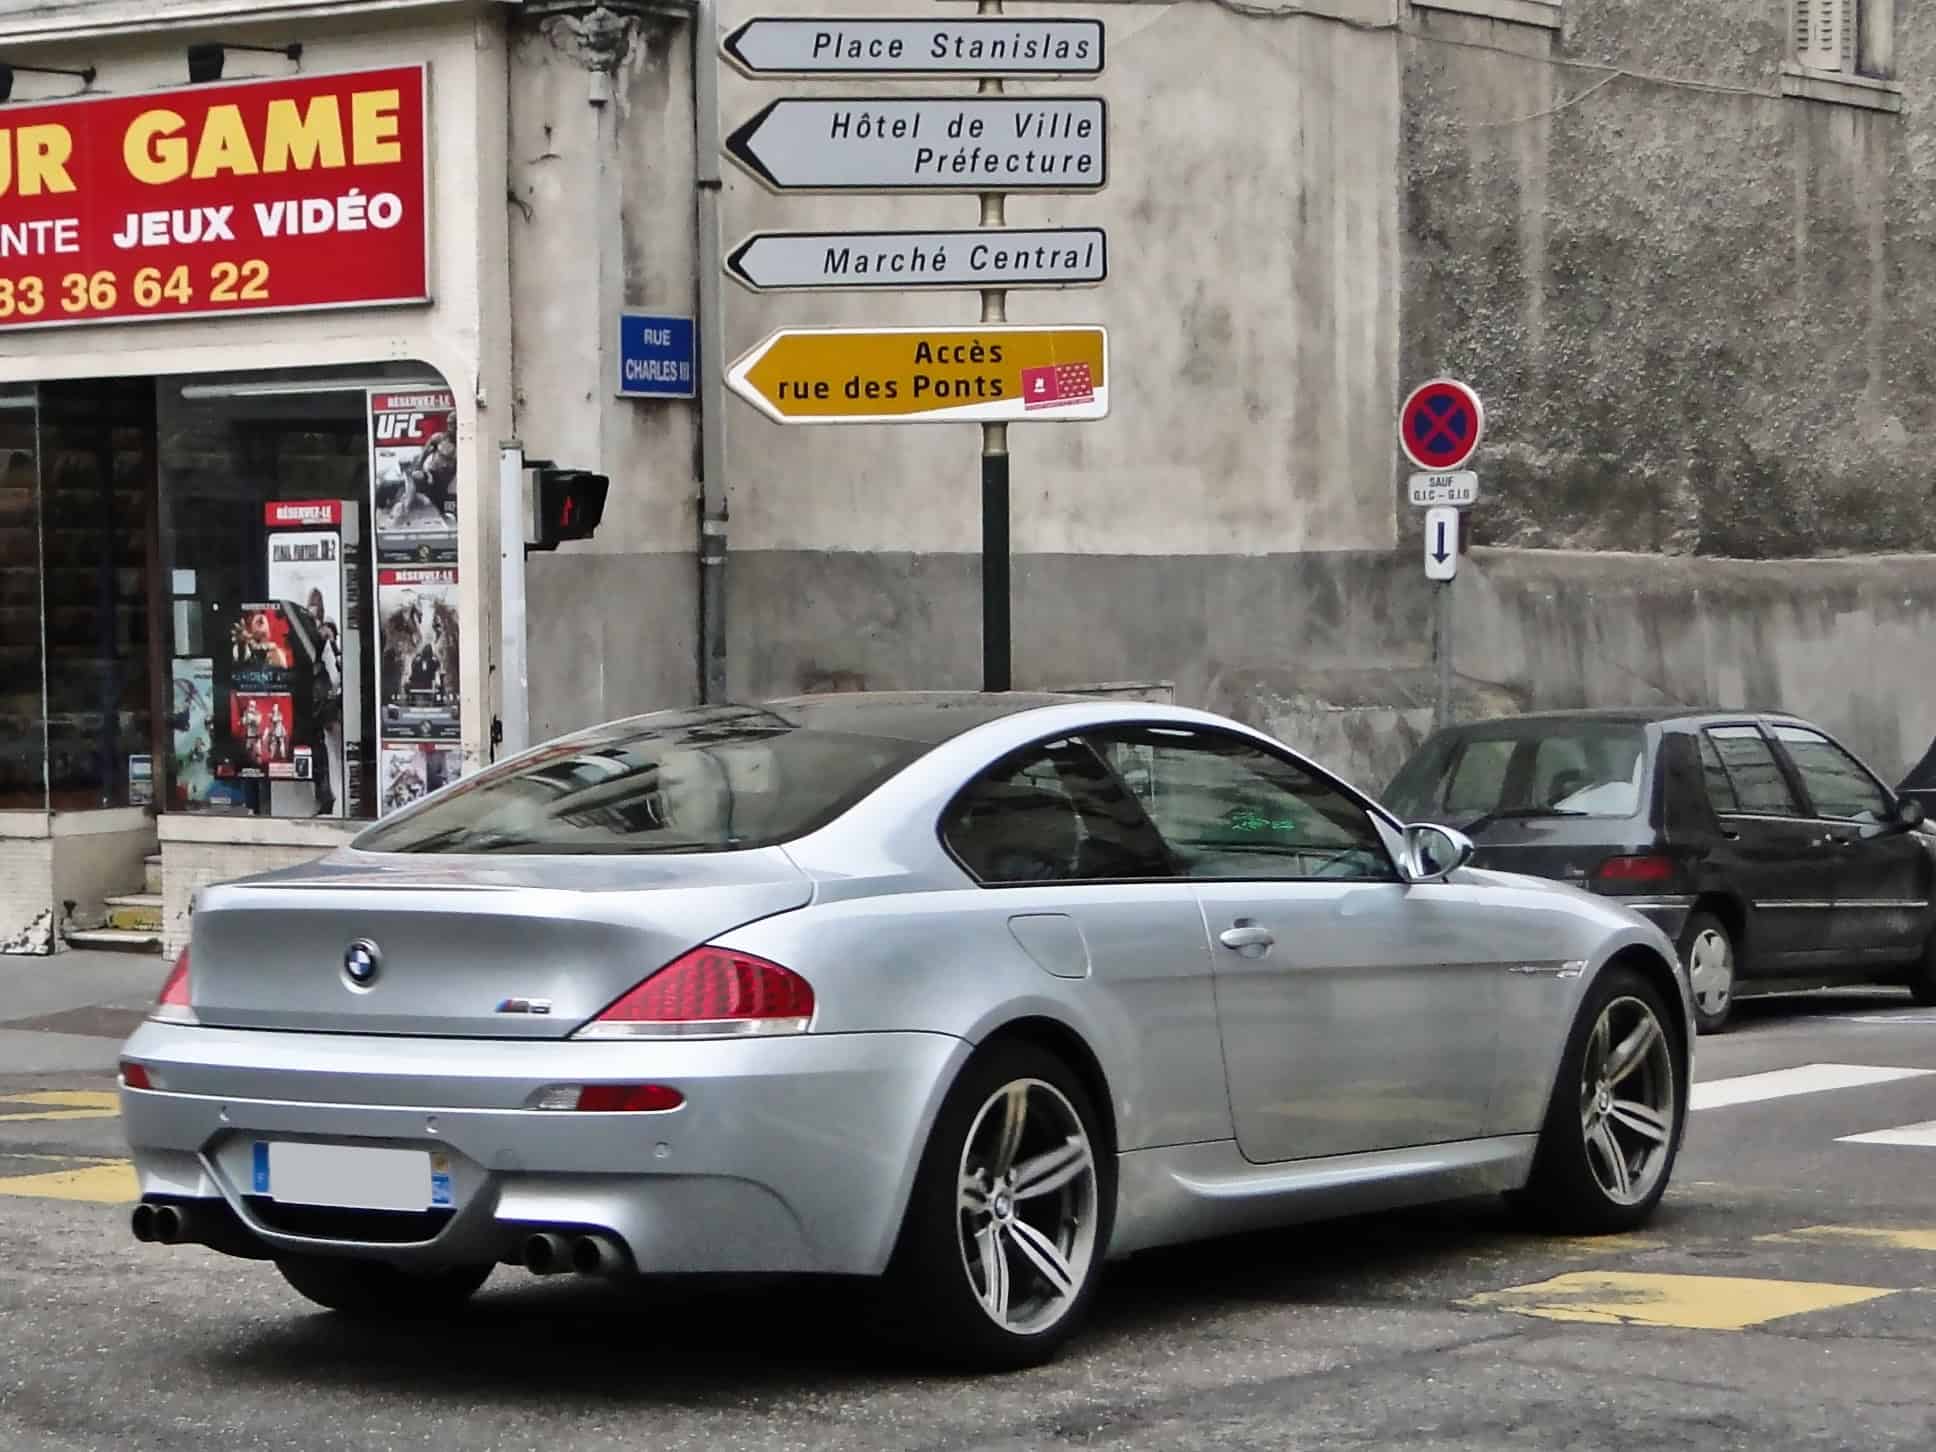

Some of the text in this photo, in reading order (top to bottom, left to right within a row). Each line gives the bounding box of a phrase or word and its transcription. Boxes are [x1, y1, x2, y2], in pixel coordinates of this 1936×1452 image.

[812, 32, 1089, 59] Place Stanislas
[123, 89, 402, 185] GAME
[831, 112, 1092, 139] Hôtel de Ville
[915, 147, 1092, 174] Préfecture
[113, 205, 235, 249] JEUX
[253, 188, 403, 239] VIDÉO
[824, 242, 1093, 274] Marché Central
[61, 271, 117, 312] 36
[132, 265, 193, 308] 64
[210, 259, 270, 302] 22
[643, 327, 672, 346] RUE
[915, 340, 1003, 364] Accès
[625, 358, 677, 381] CHARLES
[778, 375, 1004, 400] rue des Ponts
[376, 413, 424, 439] UFC
[1429, 476, 1454, 488] SAUF
